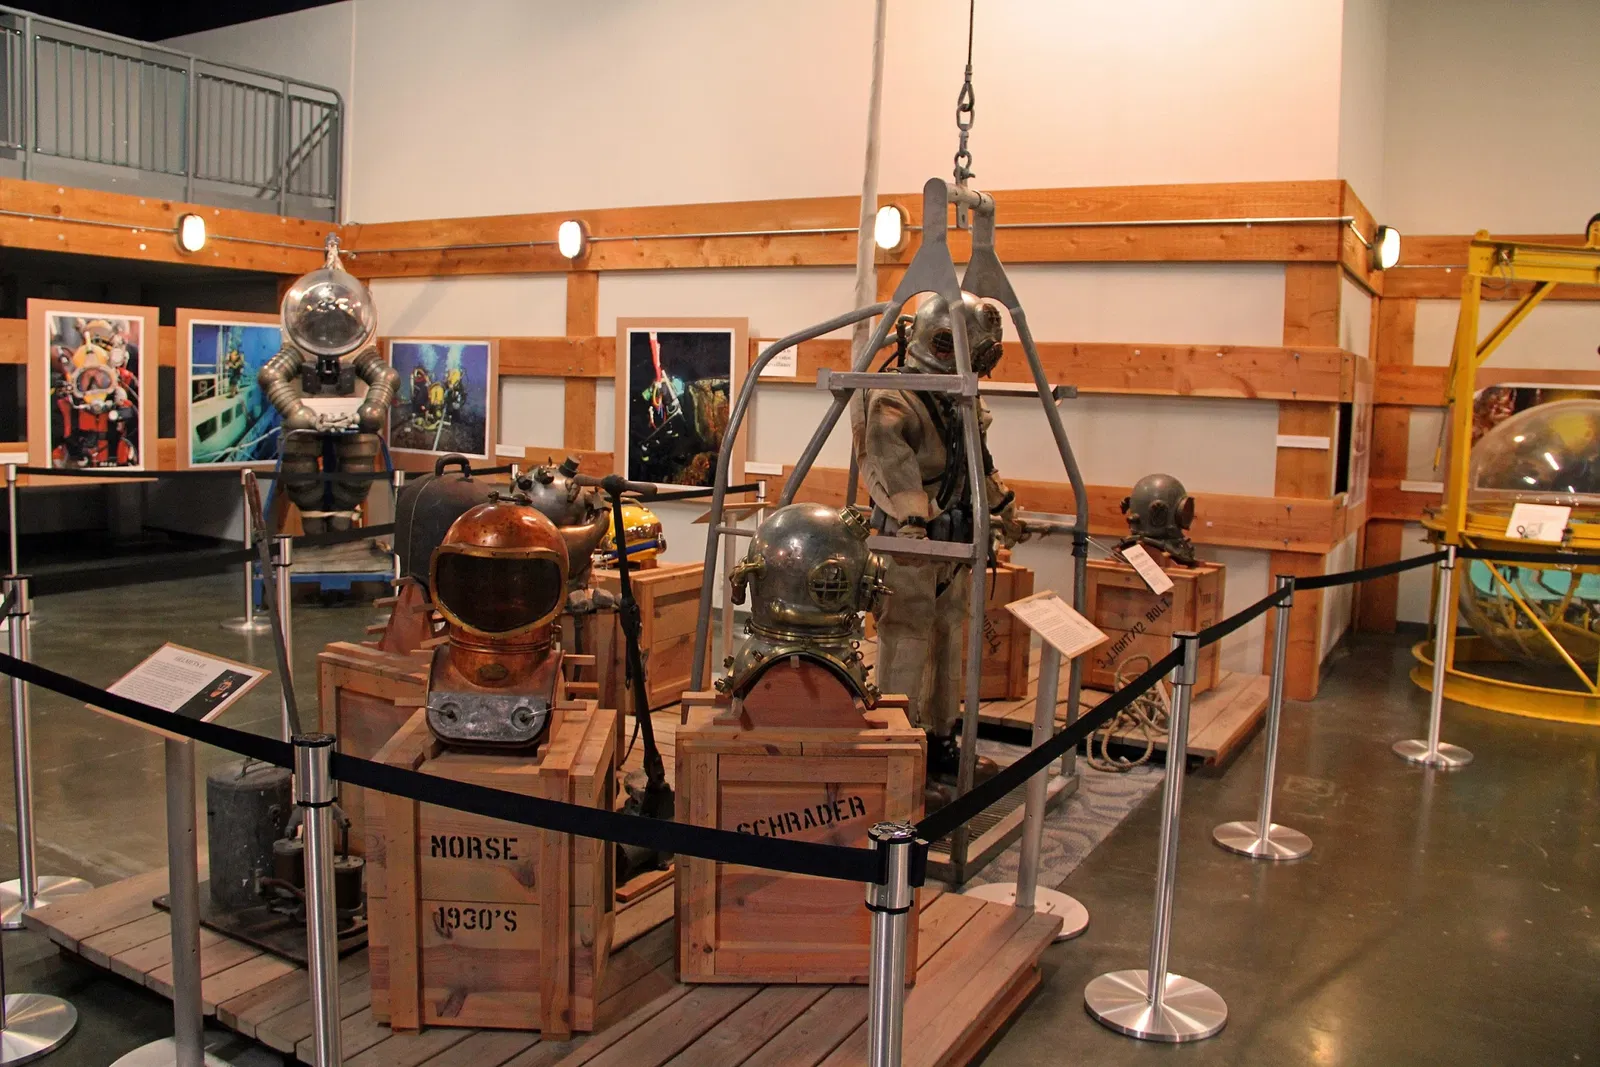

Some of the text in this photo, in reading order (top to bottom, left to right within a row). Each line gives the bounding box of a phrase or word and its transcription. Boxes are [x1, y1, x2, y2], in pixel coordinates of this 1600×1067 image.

[1145, 597, 1170, 623] BOLT
[736, 796, 866, 837] SCHRADER
[431, 835, 518, 860] MORSE
[438, 907, 518, 932] 1930'S
